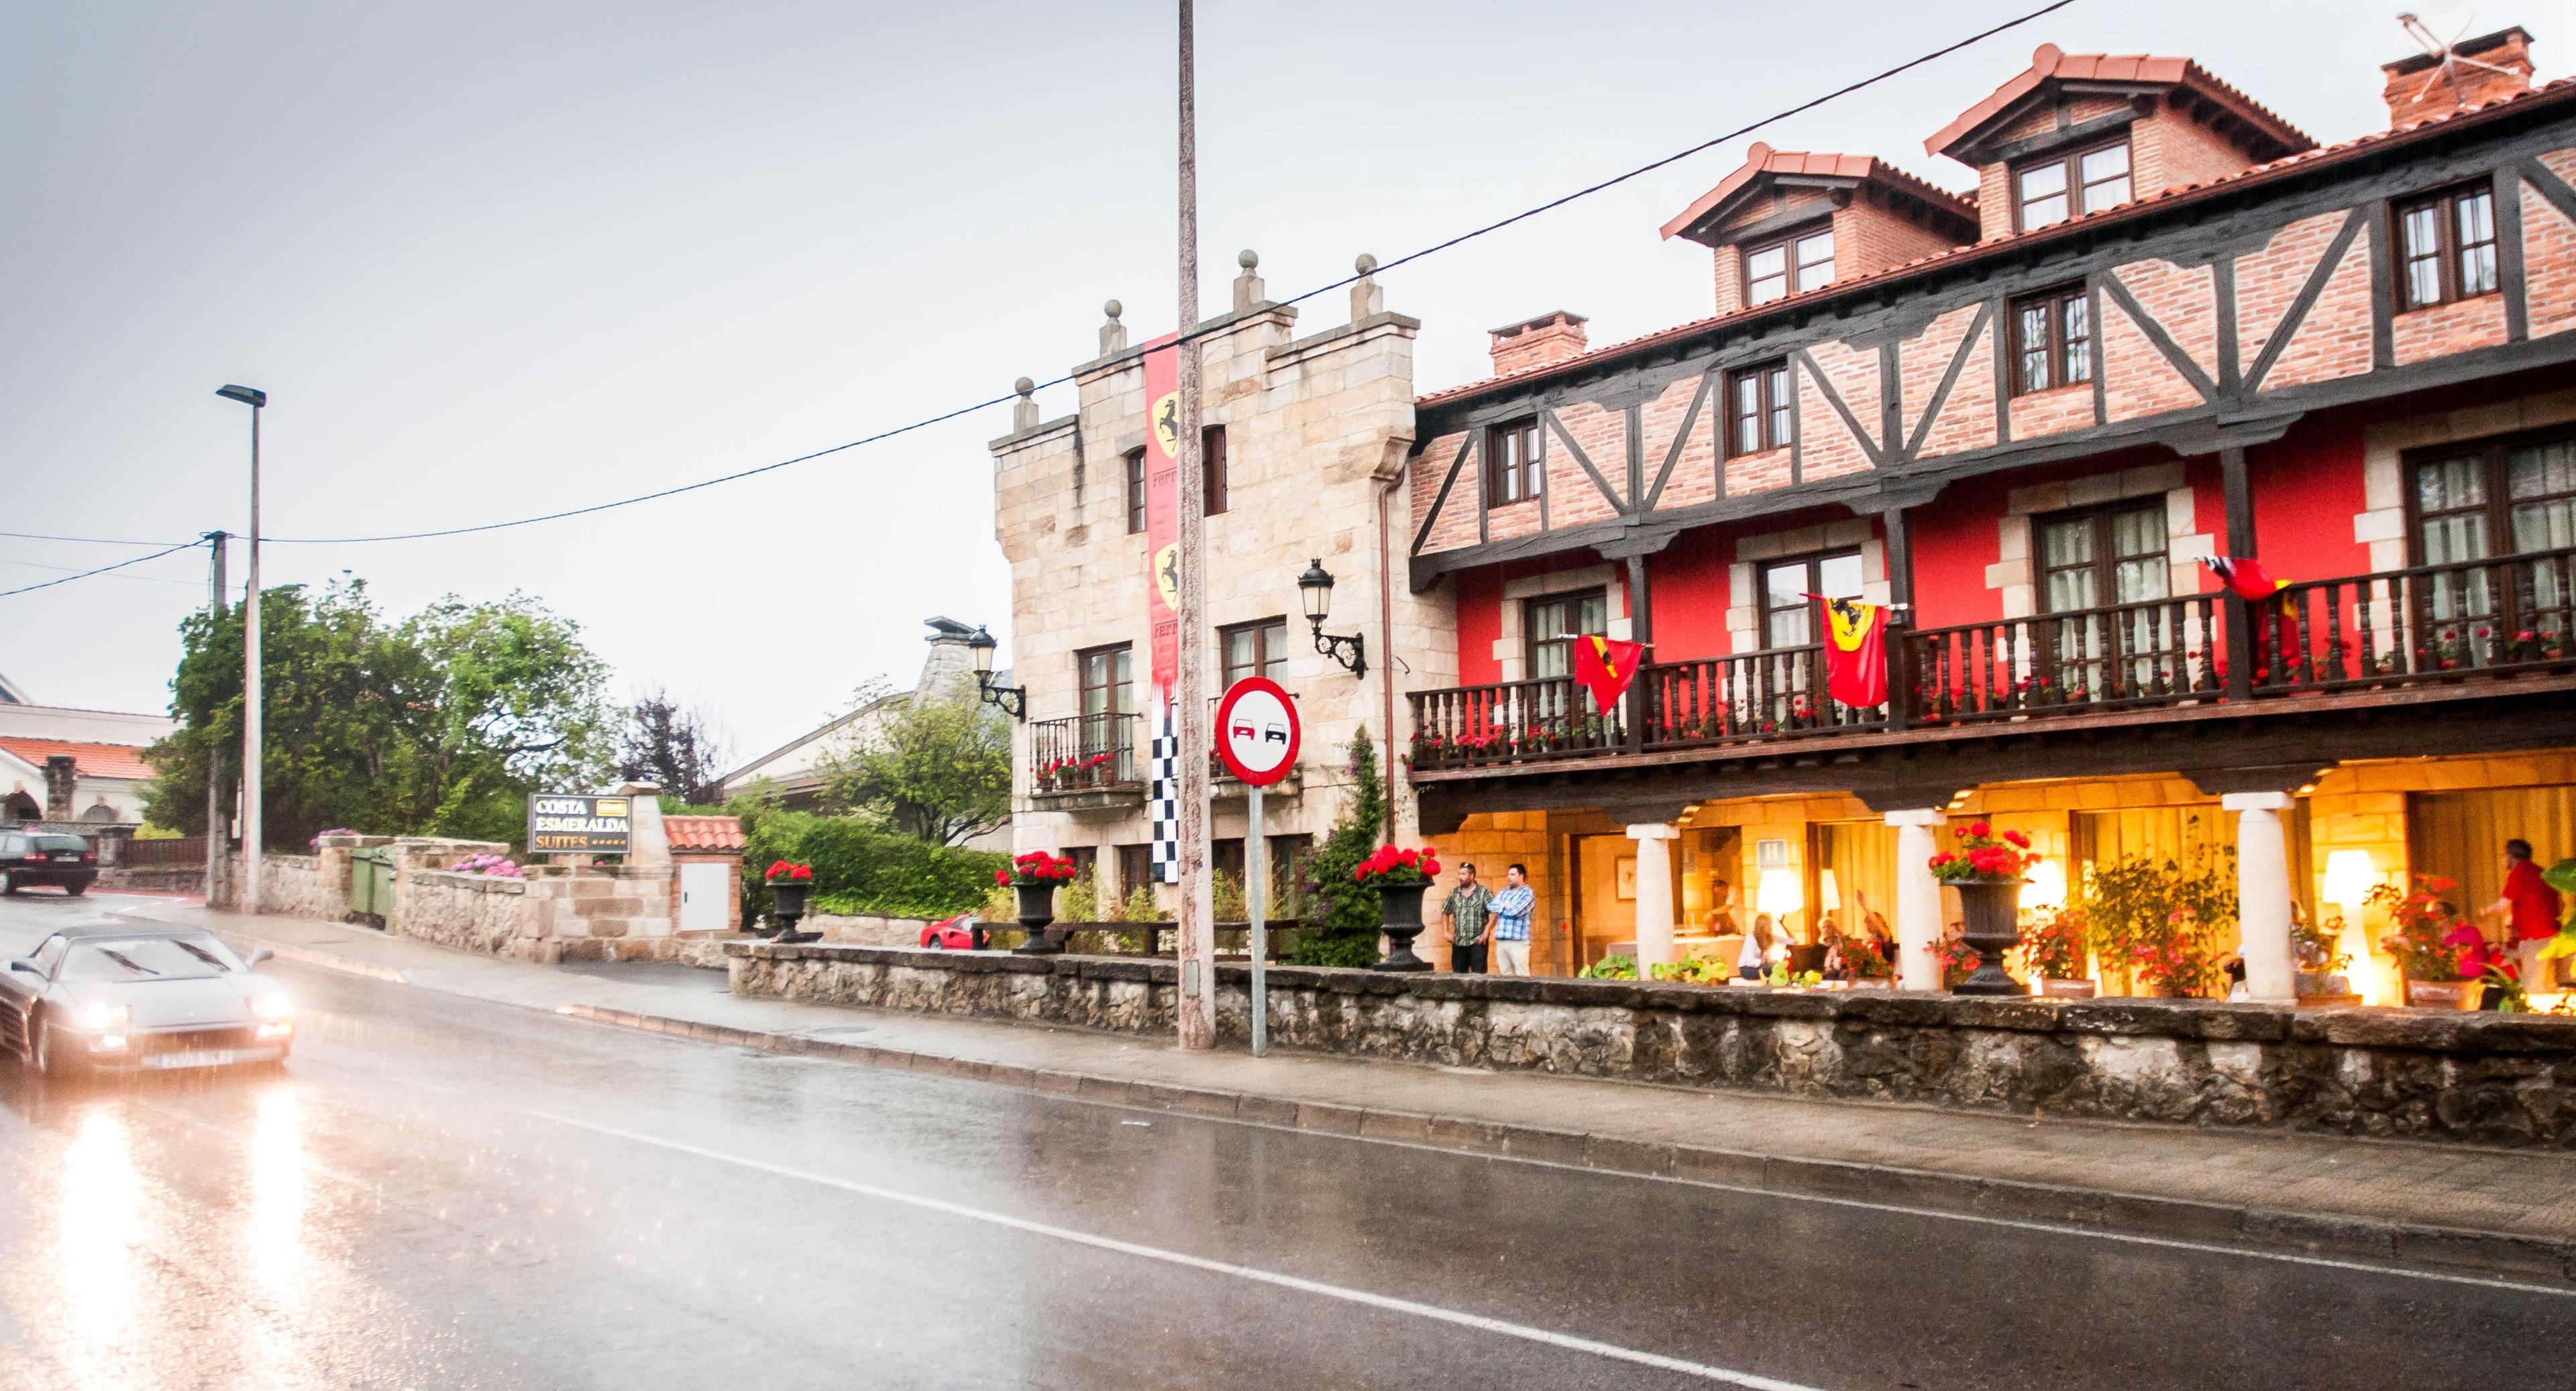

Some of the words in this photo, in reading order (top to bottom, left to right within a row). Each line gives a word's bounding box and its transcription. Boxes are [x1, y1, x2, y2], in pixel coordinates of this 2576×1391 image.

[535, 799, 587, 814] COSTA
[535, 817, 629, 832] ESMERALDA
[536, 836, 588, 848] SUITES
